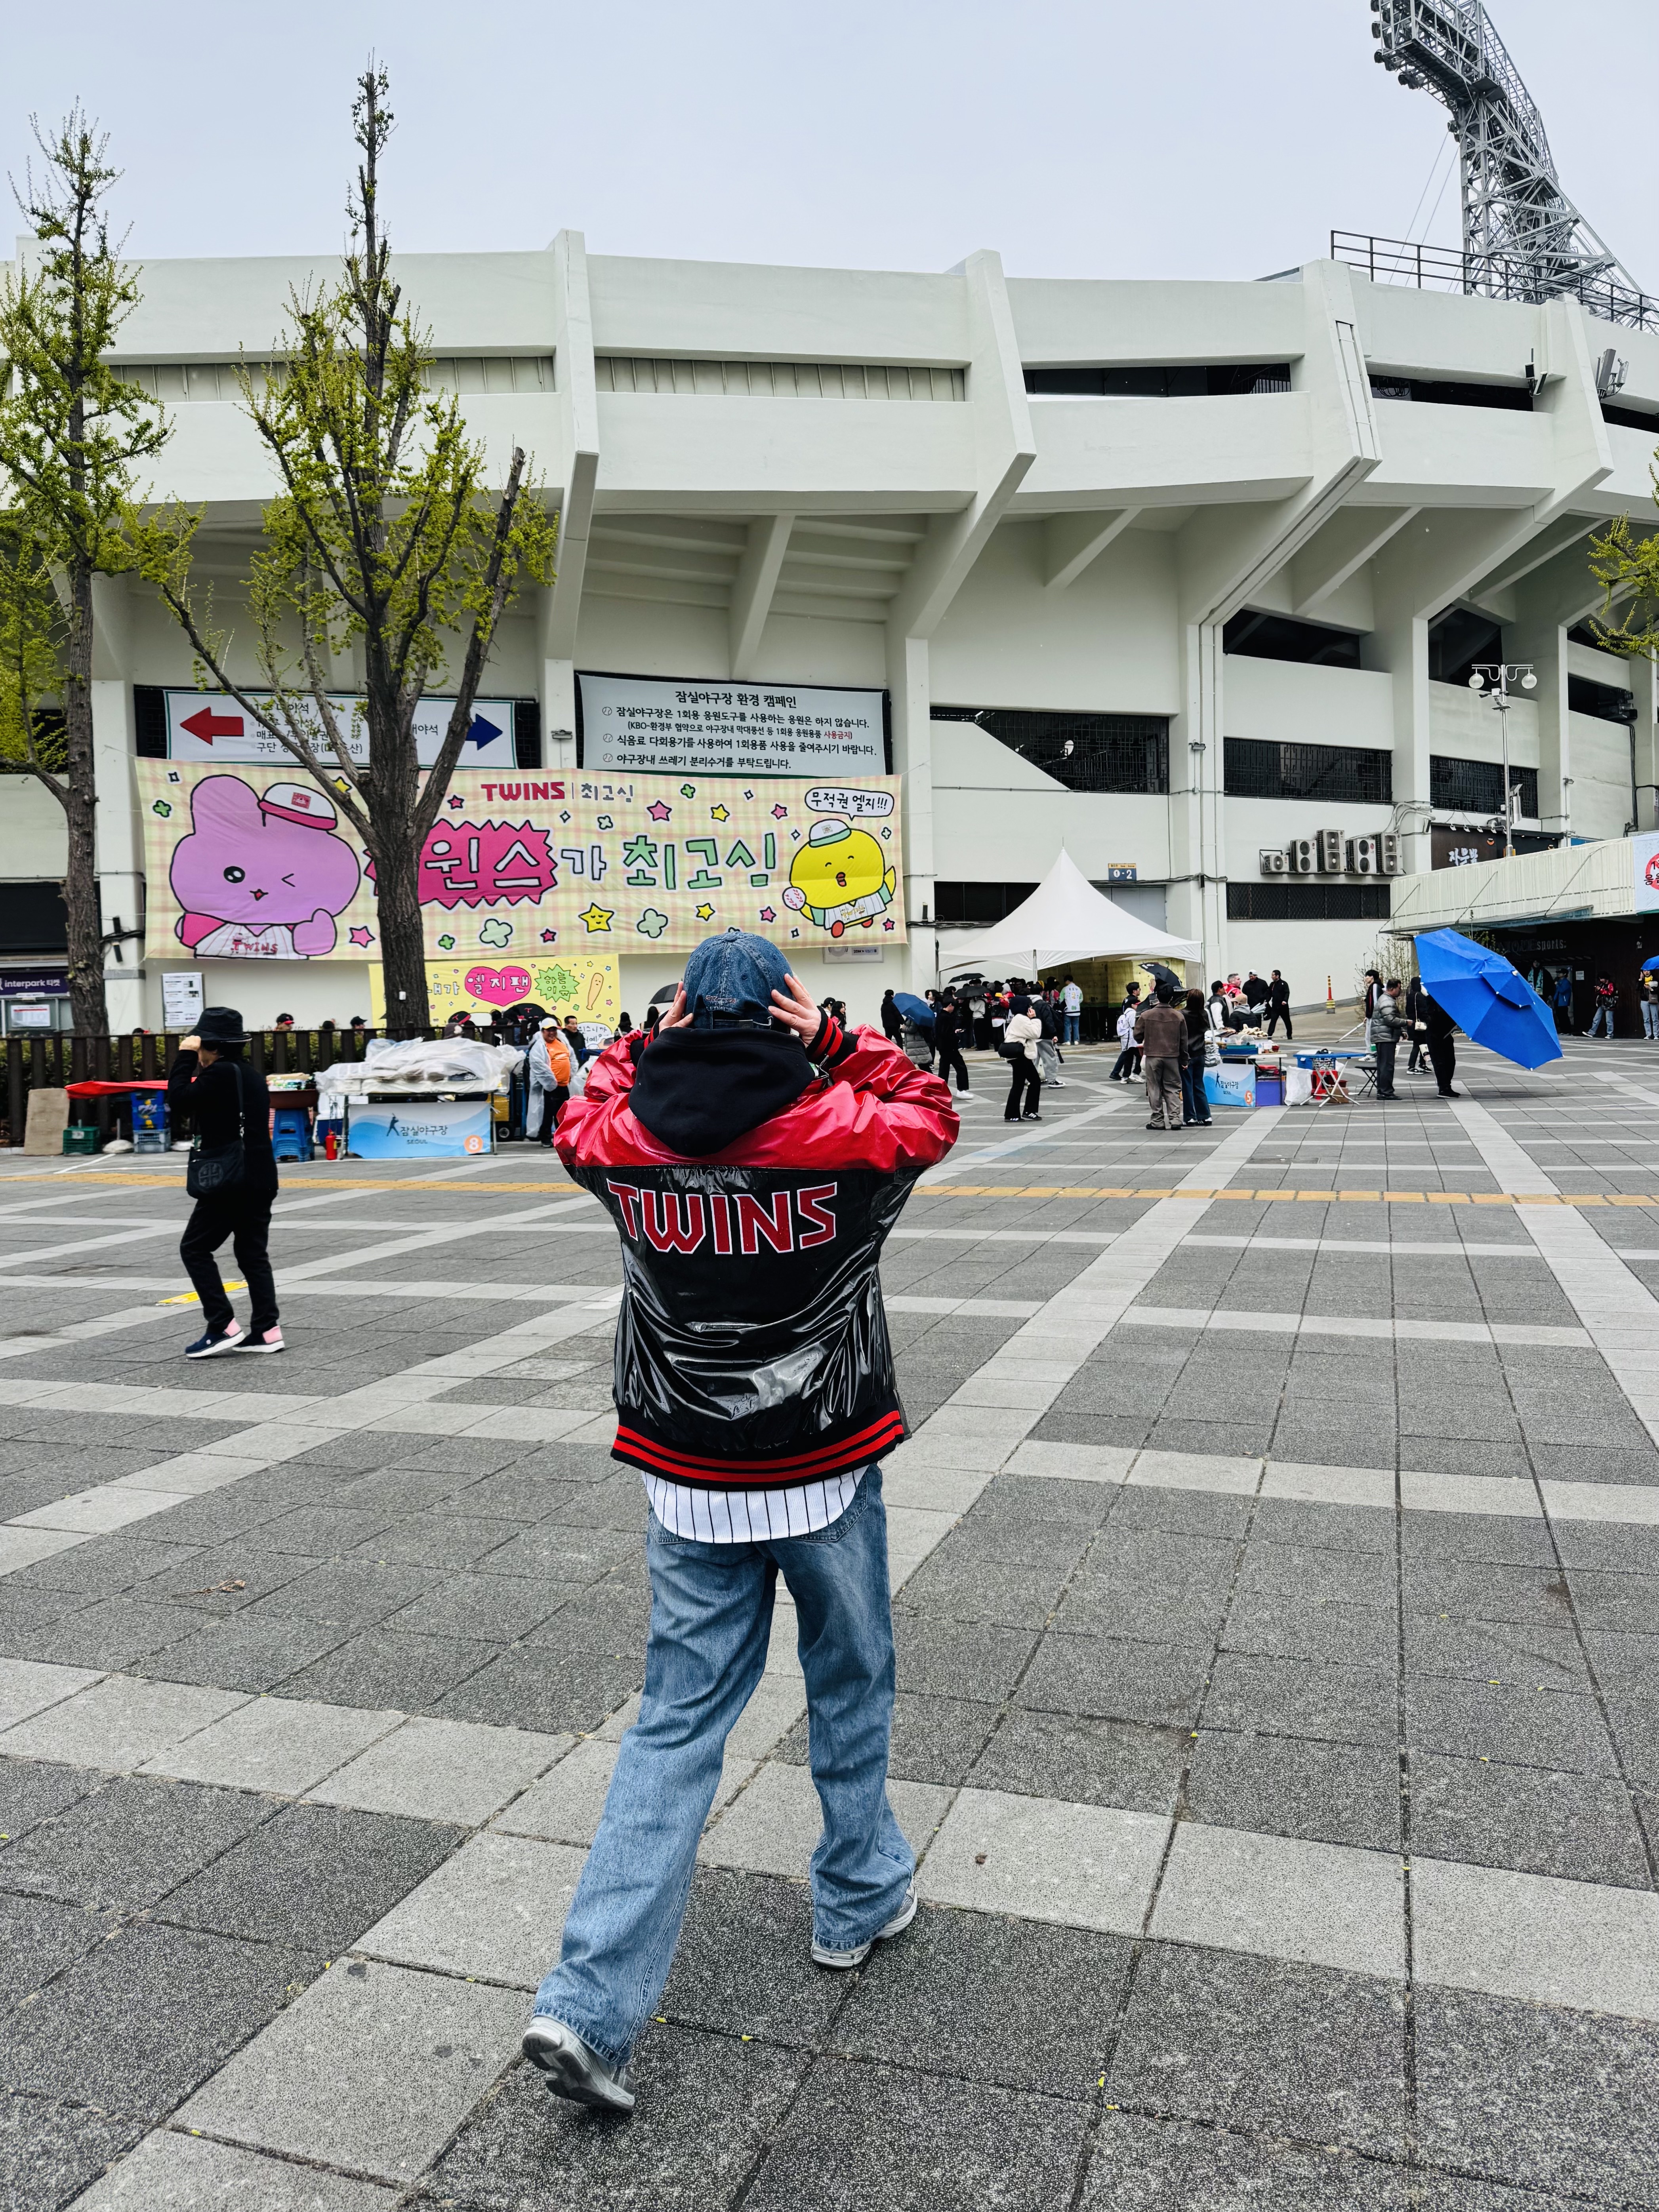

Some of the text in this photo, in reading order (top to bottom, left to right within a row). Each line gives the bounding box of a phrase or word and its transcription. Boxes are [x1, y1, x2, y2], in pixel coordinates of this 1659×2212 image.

[675, 691, 797, 708] 잠실야구장 환경 캠페인
[616, 707, 869, 728] 잠실야구장은 1회용 응원도구를 사용하는 응원은 하지 않습니다.
[628, 721, 852, 739] (KBO-환경부 협약으로 야구장내 막대풍선 등 1회용 응원용품 사용금지)
[257, 742, 277, 753] 구단
[617, 735, 877, 755] 식음료 다회용기를 사용하여 1회용품 사용을 줄여주시기 바랍니다.
[617, 754, 791, 769] 야구장내 쓰레기 분리수거를 부탁드립니다.
[481, 782, 633, 803] TWINS 최고심
[811, 792, 887, 812] 무적권 엘지!!!
[425, 832, 775, 891] 윈스가 최고심
[5, 979, 45, 989] interpark
[467, 974, 529, 995] 엘지팬
[544, 972, 566, 984] 하는
[547, 985, 569, 996] 이유
[1246, 1092, 1252, 1102] 5
[400, 1126, 448, 1136] 잠실야구장
[469, 1137, 479, 1150] 8
[606, 1178, 837, 1255] TWINS
